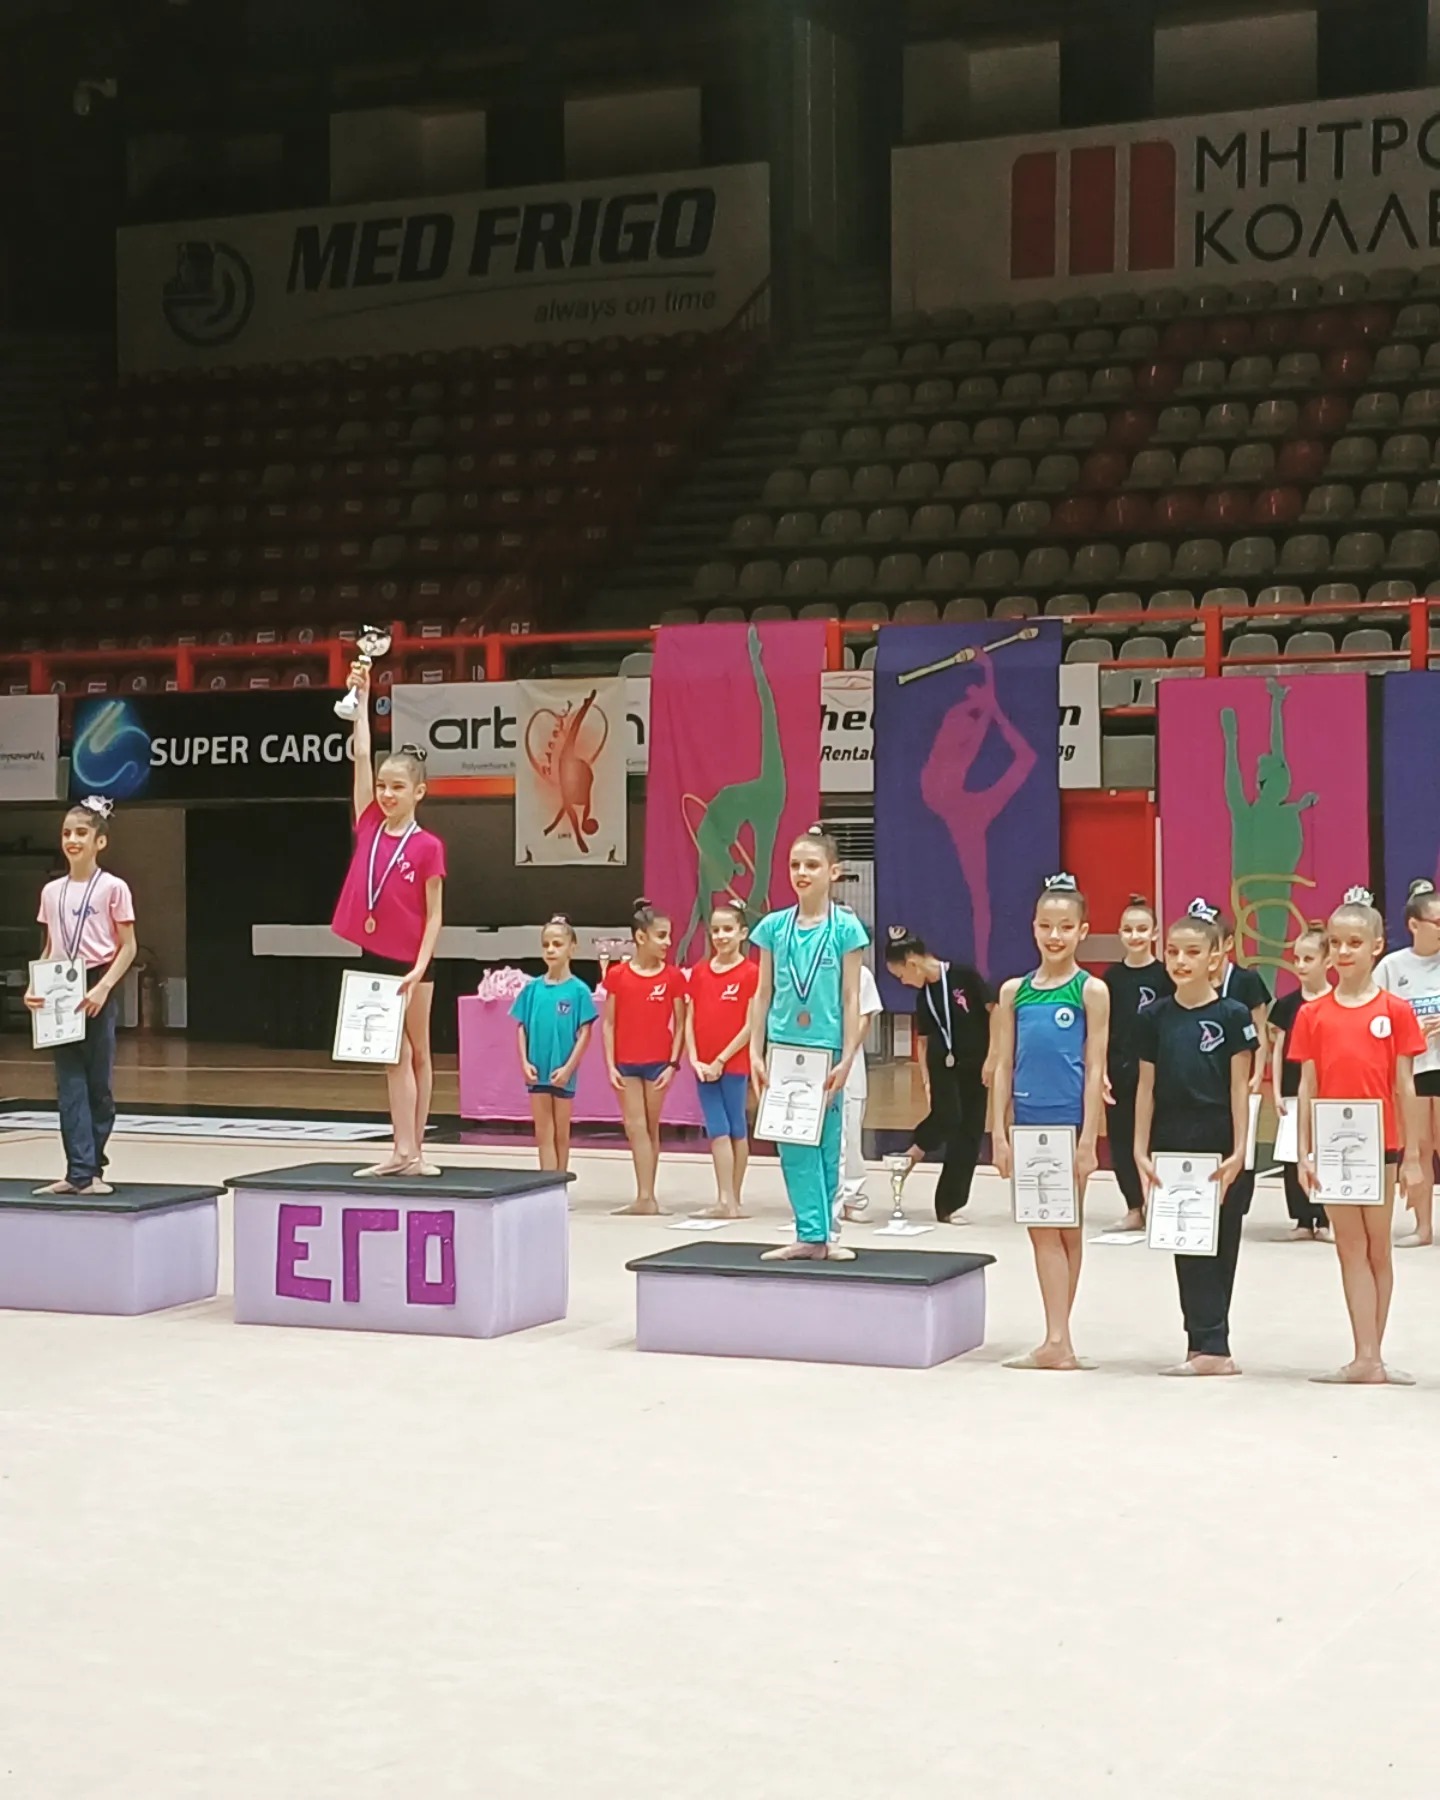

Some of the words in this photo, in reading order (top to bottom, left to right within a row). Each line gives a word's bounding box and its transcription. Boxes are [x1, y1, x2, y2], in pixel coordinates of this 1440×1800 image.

[287, 212, 455, 294] MED
[468, 188, 716, 276] FRIGO
[534, 298, 617, 325] always
[625, 295, 656, 316] on
[665, 288, 716, 312] time
[820, 705, 874, 731] he
[150, 737, 249, 766] SUPER
[276, 1203, 456, 1305] ΕΓΟ
